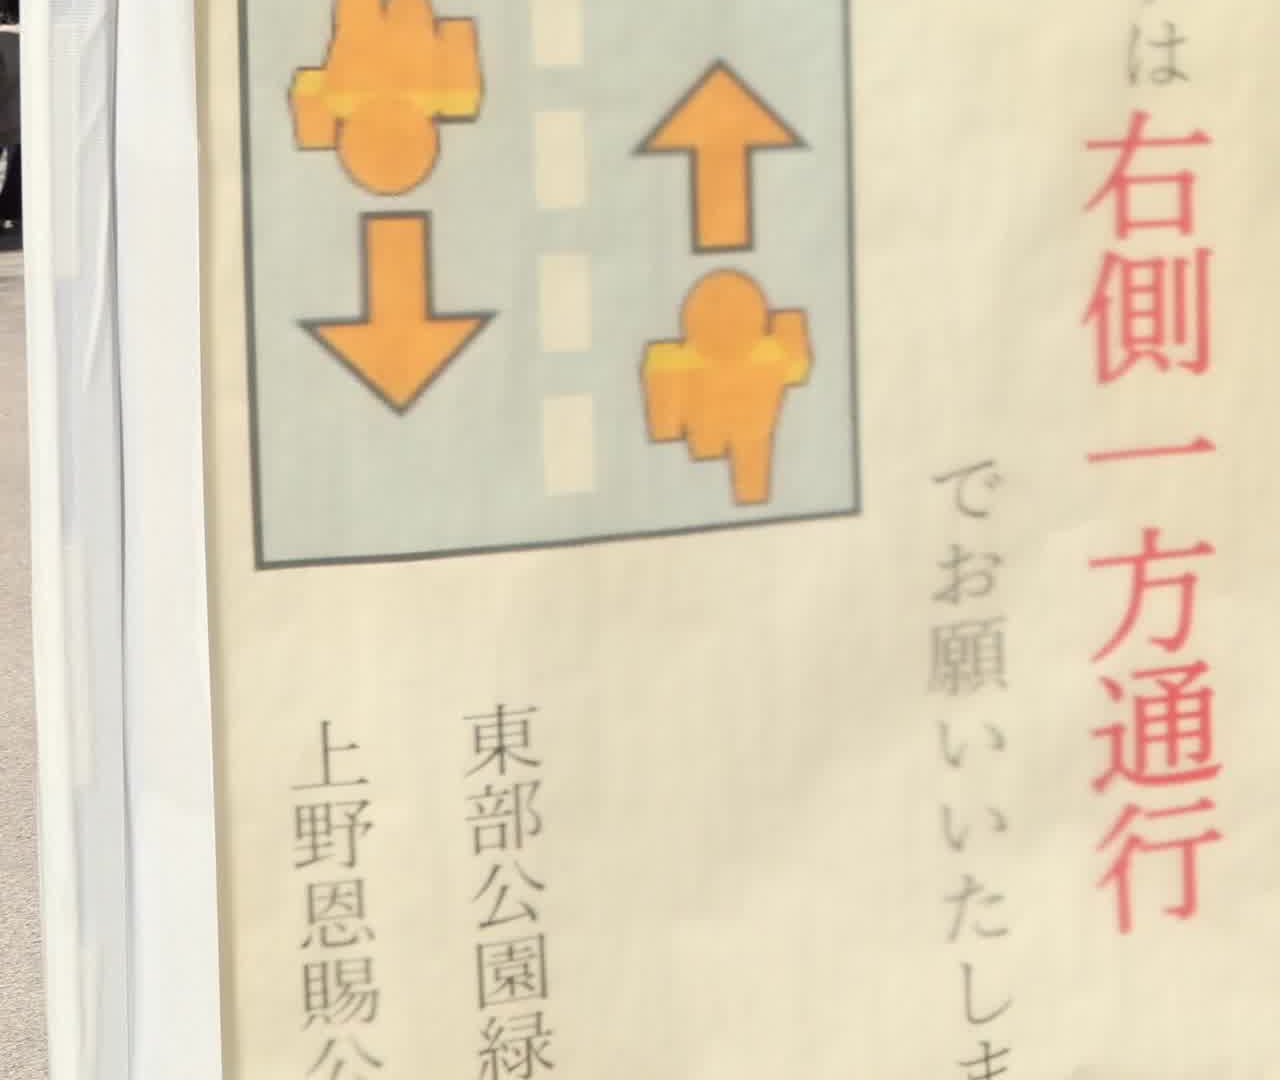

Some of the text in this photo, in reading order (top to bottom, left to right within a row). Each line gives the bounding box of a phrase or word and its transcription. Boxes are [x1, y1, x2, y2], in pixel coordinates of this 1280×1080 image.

[290, 720, 383, 1080] 上野恩賜公
[464, 704, 556, 1080] 東部公園緑
